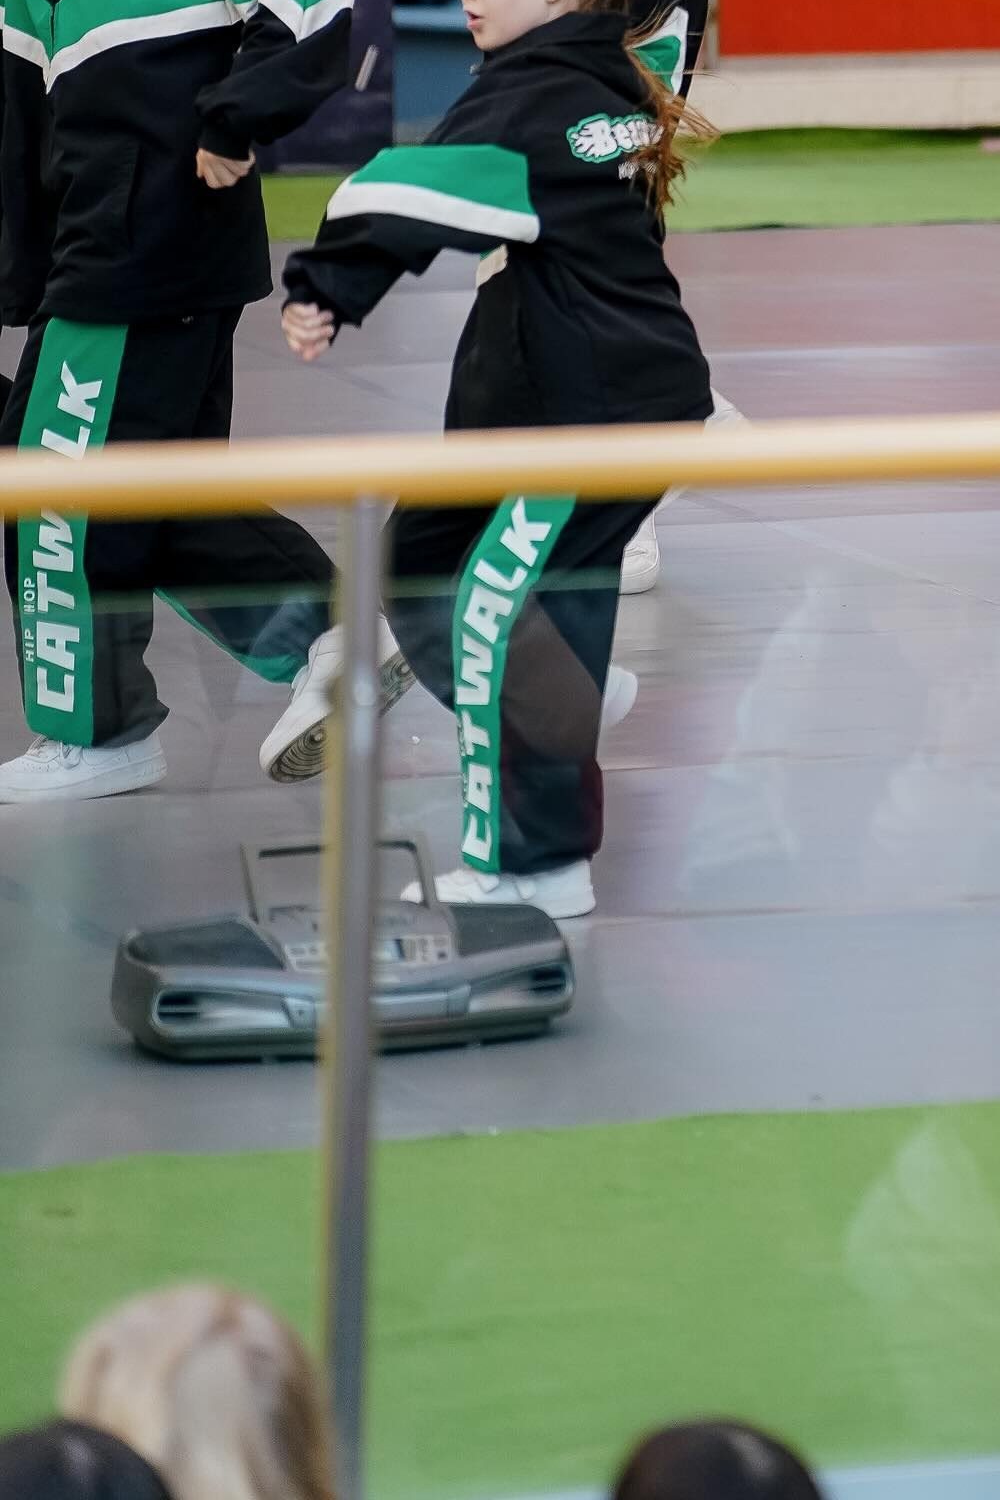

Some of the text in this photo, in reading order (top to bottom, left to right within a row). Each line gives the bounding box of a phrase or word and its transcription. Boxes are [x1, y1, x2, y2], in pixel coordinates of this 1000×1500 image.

[23, 577, 36, 663] HIP HOP
[33, 360, 103, 713] CATWLK
[456, 496, 553, 864] CATWALK
